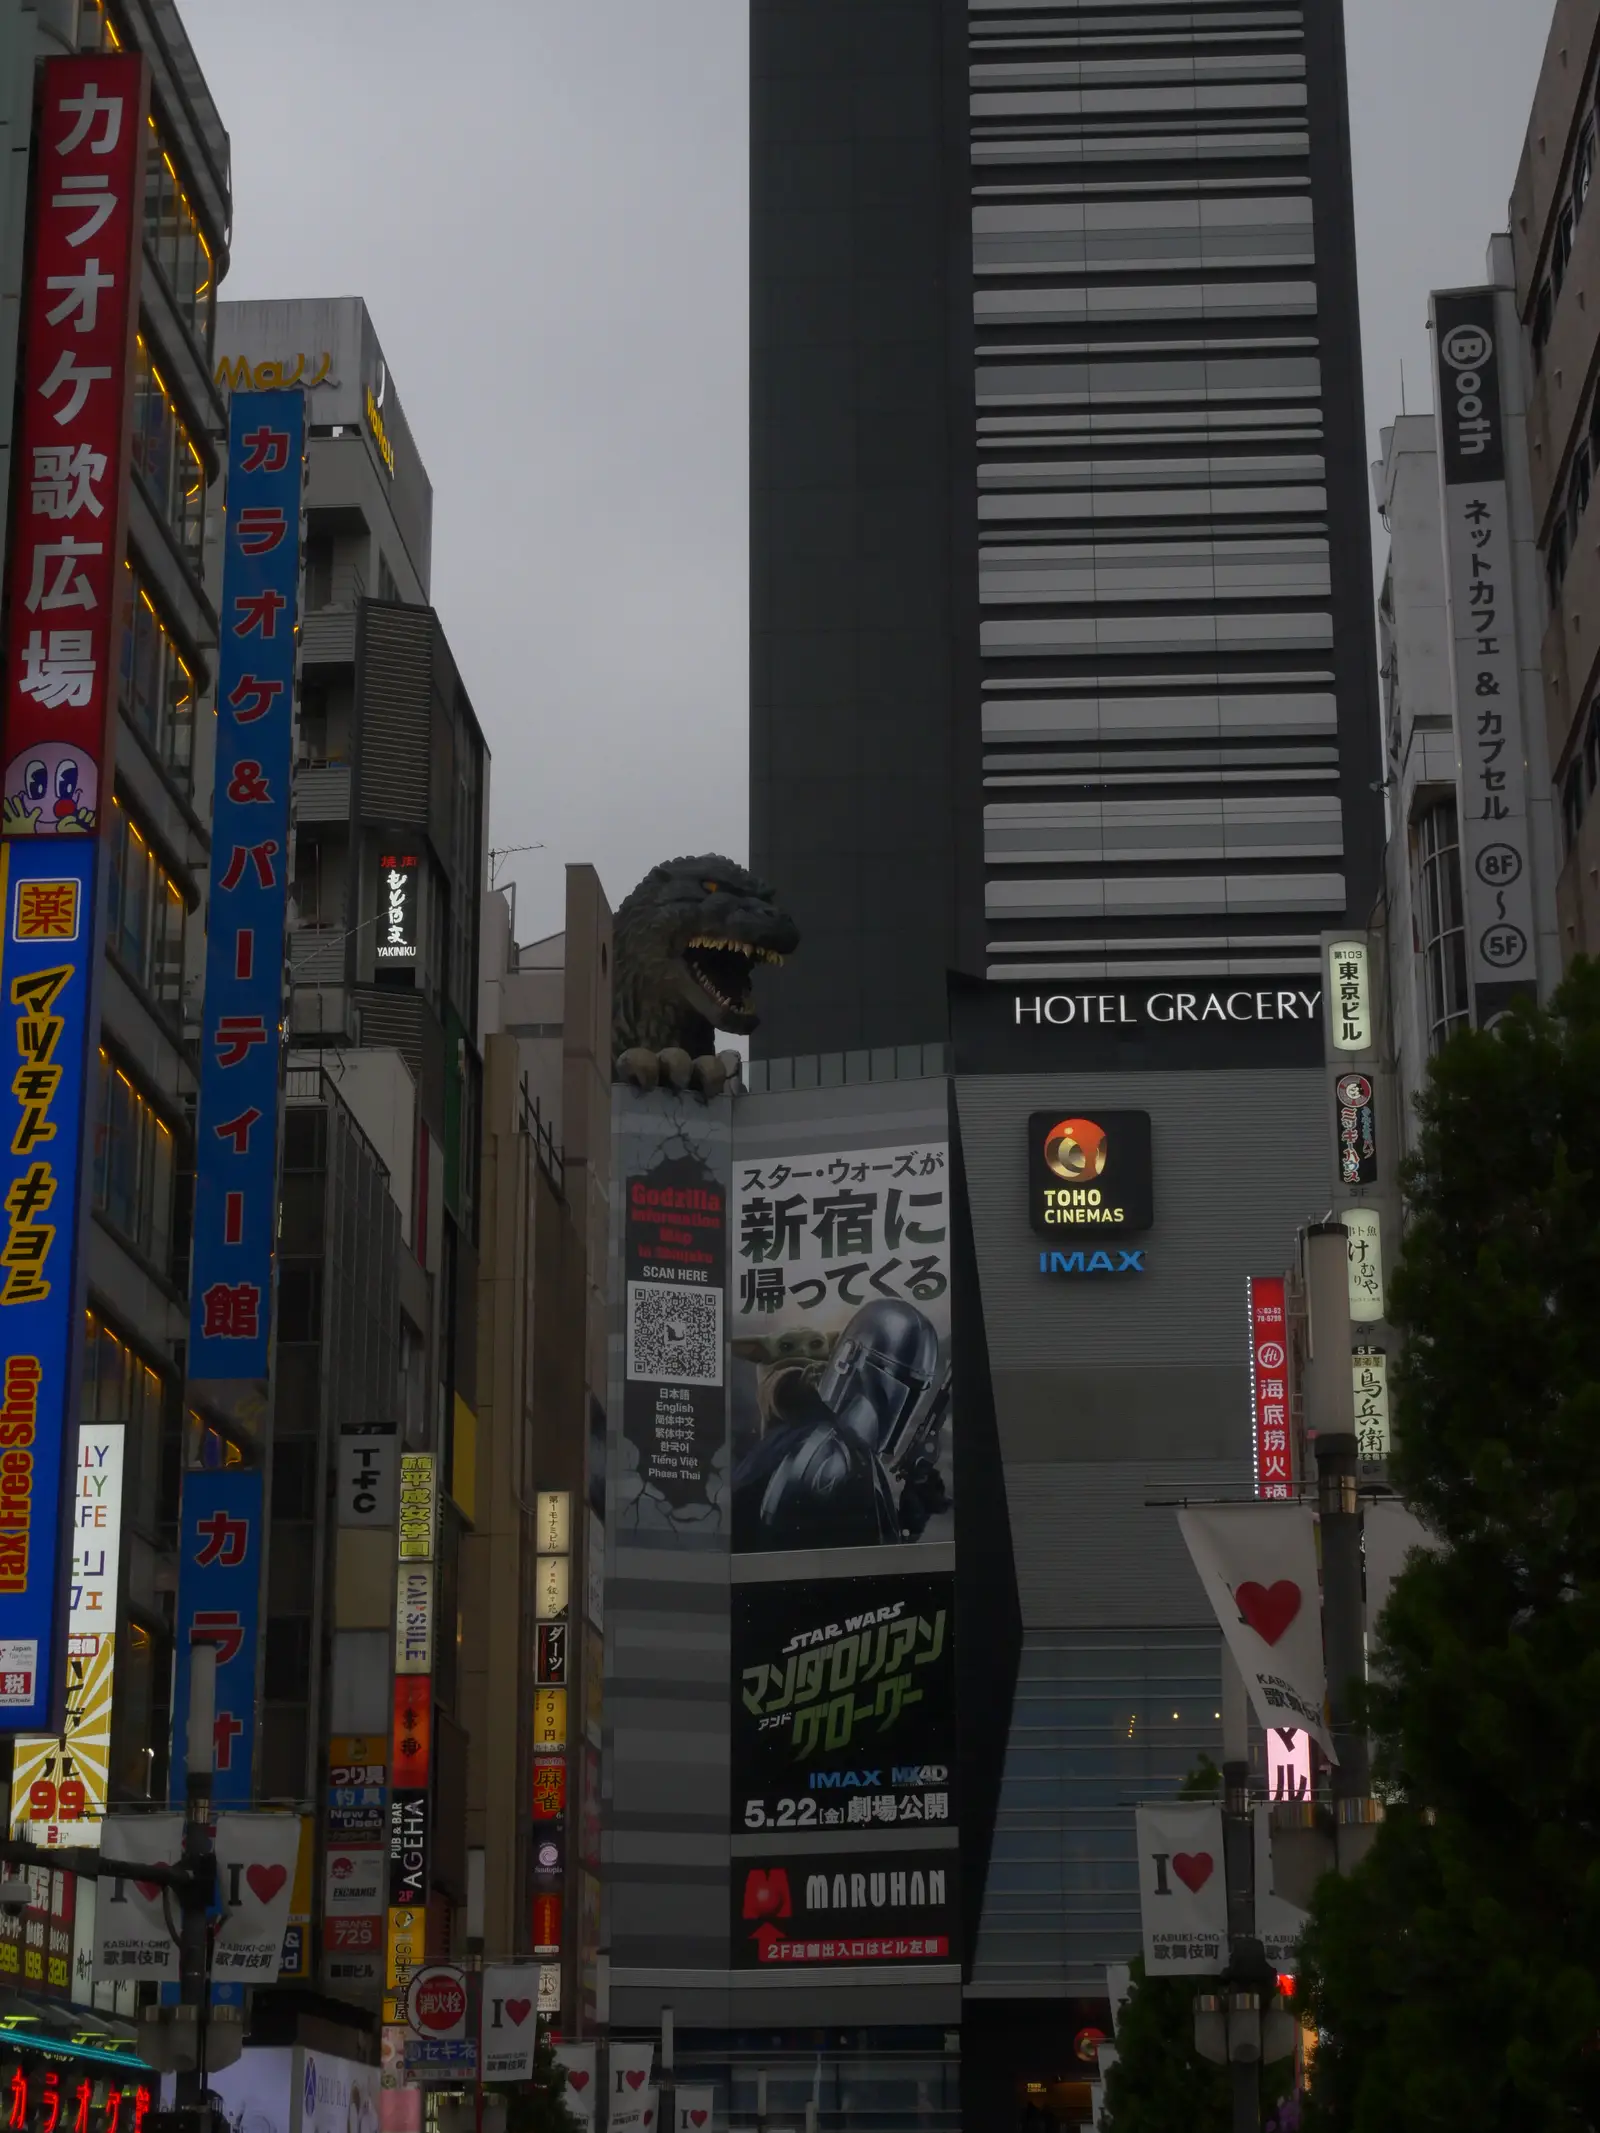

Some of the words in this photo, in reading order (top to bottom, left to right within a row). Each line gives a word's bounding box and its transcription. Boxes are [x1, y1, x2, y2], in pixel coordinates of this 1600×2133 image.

[19, 83, 124, 709] カラオケ歌広場
[1442, 324, 1493, 455] Booth
[1464, 500, 1500, 656] ネットカフェ
[1477, 710, 1509, 821] カプセル
[1485, 855, 1513, 875] 8F
[21, 886, 79, 935] 薬
[377, 946, 416, 957] YAKINIKU
[1489, 936, 1518, 957] 5F
[1014, 994, 1137, 1025] HOTEL
[1146, 990, 1322, 1022] GRACERY
[1338, 962, 1363, 1041] 東京ビル
[3, 966, 73, 1304] マツモトキヨシ
[741, 1150, 944, 1191] スター・ウォーズが
[631, 1182, 721, 1211] Godzilla
[1044, 1189, 1101, 1207] TOHO
[631, 1207, 720, 1228] Information
[739, 1188, 946, 1263] 新宿に
[1044, 1208, 1125, 1224] CINEMAS
[1039, 1250, 1145, 1272] IMAX
[643, 1265, 675, 1280] SCAN
[678, 1267, 708, 1282] HERE
[740, 1255, 947, 1315] 帰ってくる
[1357, 1346, 1376, 1355] 5F
[659, 1388, 690, 1401] 日本語
[656, 1401, 694, 1414] English
[660, 1441, 689, 1454] 한국어
[680, 1470, 701, 1480] Thai
[782, 1622, 843, 1654] STAR
[845, 1600, 906, 1632] WARS
[548, 1626, 564, 1671] ダーツ
[741, 1609, 947, 1716] マンダロリアン
[757, 1712, 793, 1731] アンド
[790, 1672, 925, 1763] グローグー
[331, 1766, 384, 1785] つり具
[808, 1768, 884, 1789] IMAX
[891, 1764, 949, 1785] MX4D
[534, 1767, 563, 1812] 麻雀
[30, 1781, 86, 1820] 99
[330, 1810, 365, 1820] New
[368, 1809, 379, 1819] &
[391, 1802, 402, 1822] BAR
[343, 1819, 383, 1828] Used
[392, 1828, 402, 1838] &
[391, 1840, 402, 1859] PUB
[403, 1799, 424, 1889] AGEHA
[1152, 1853, 1172, 1895] I
[227, 1864, 244, 1906] I
[805, 1869, 946, 1909] MARUHAN
[397, 1890, 414, 1903] 2F
[103, 1940, 170, 1949] KABUKI-CHO
[219, 1942, 276, 1952] KABUKI-CHO
[334, 1930, 373, 1945] 729
[1152, 1933, 1220, 1942] KABUKI-CHO
[103, 1950, 170, 1967] 歌舞伎町
[215, 1953, 273, 1969] 歌舞伎町
[1154, 1945, 1220, 1960] 歌舞伎町
[419, 1993, 463, 2016] 消火栓
[491, 1998, 504, 2028] I
